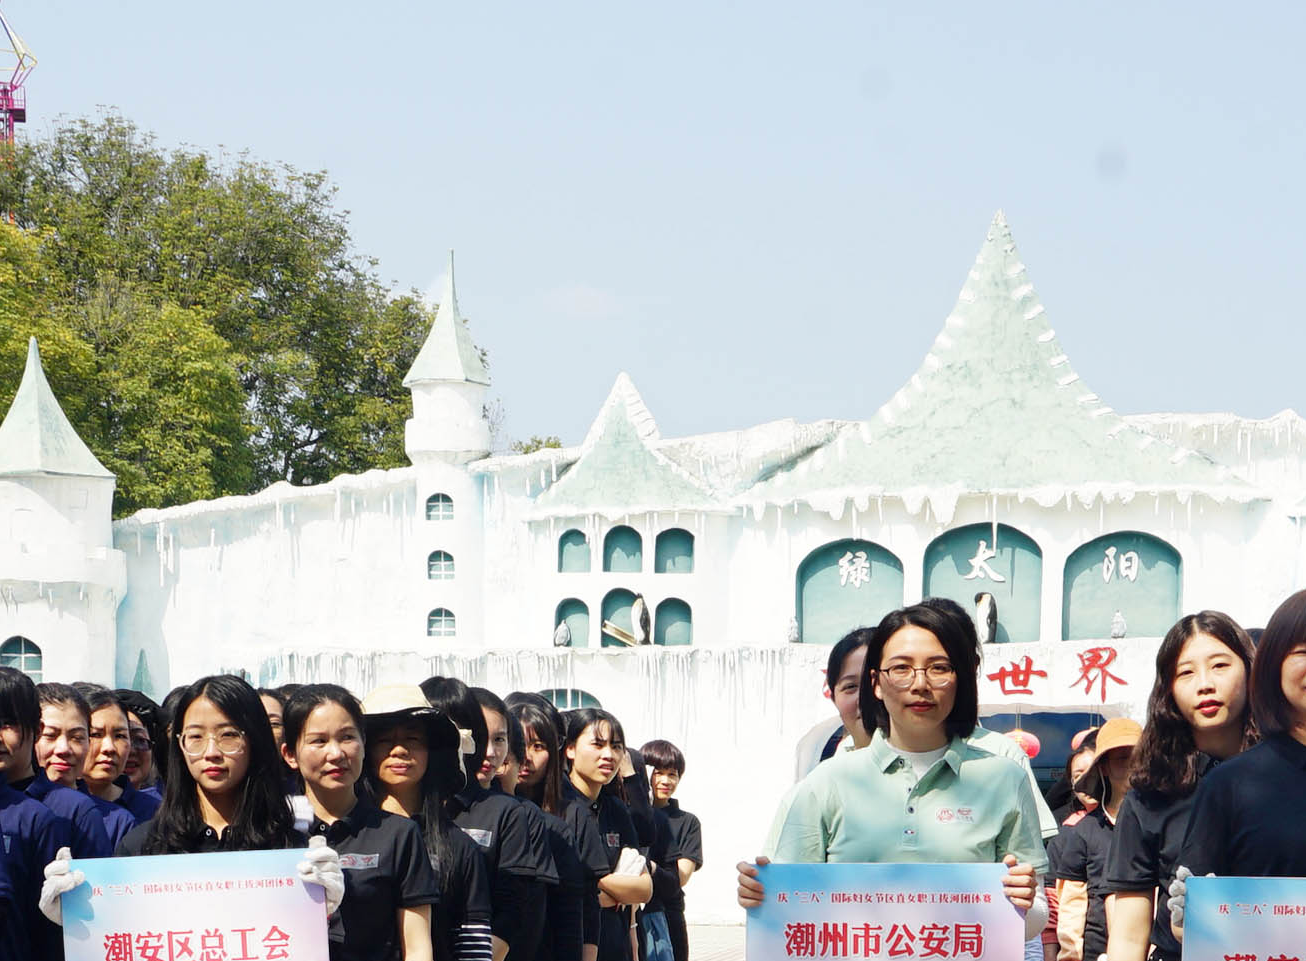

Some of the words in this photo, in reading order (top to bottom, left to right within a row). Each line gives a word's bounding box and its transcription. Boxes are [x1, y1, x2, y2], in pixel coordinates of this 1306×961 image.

[839, 540, 1139, 588] 绿太阳
[784, 922, 984, 958] 潮州市公安局
